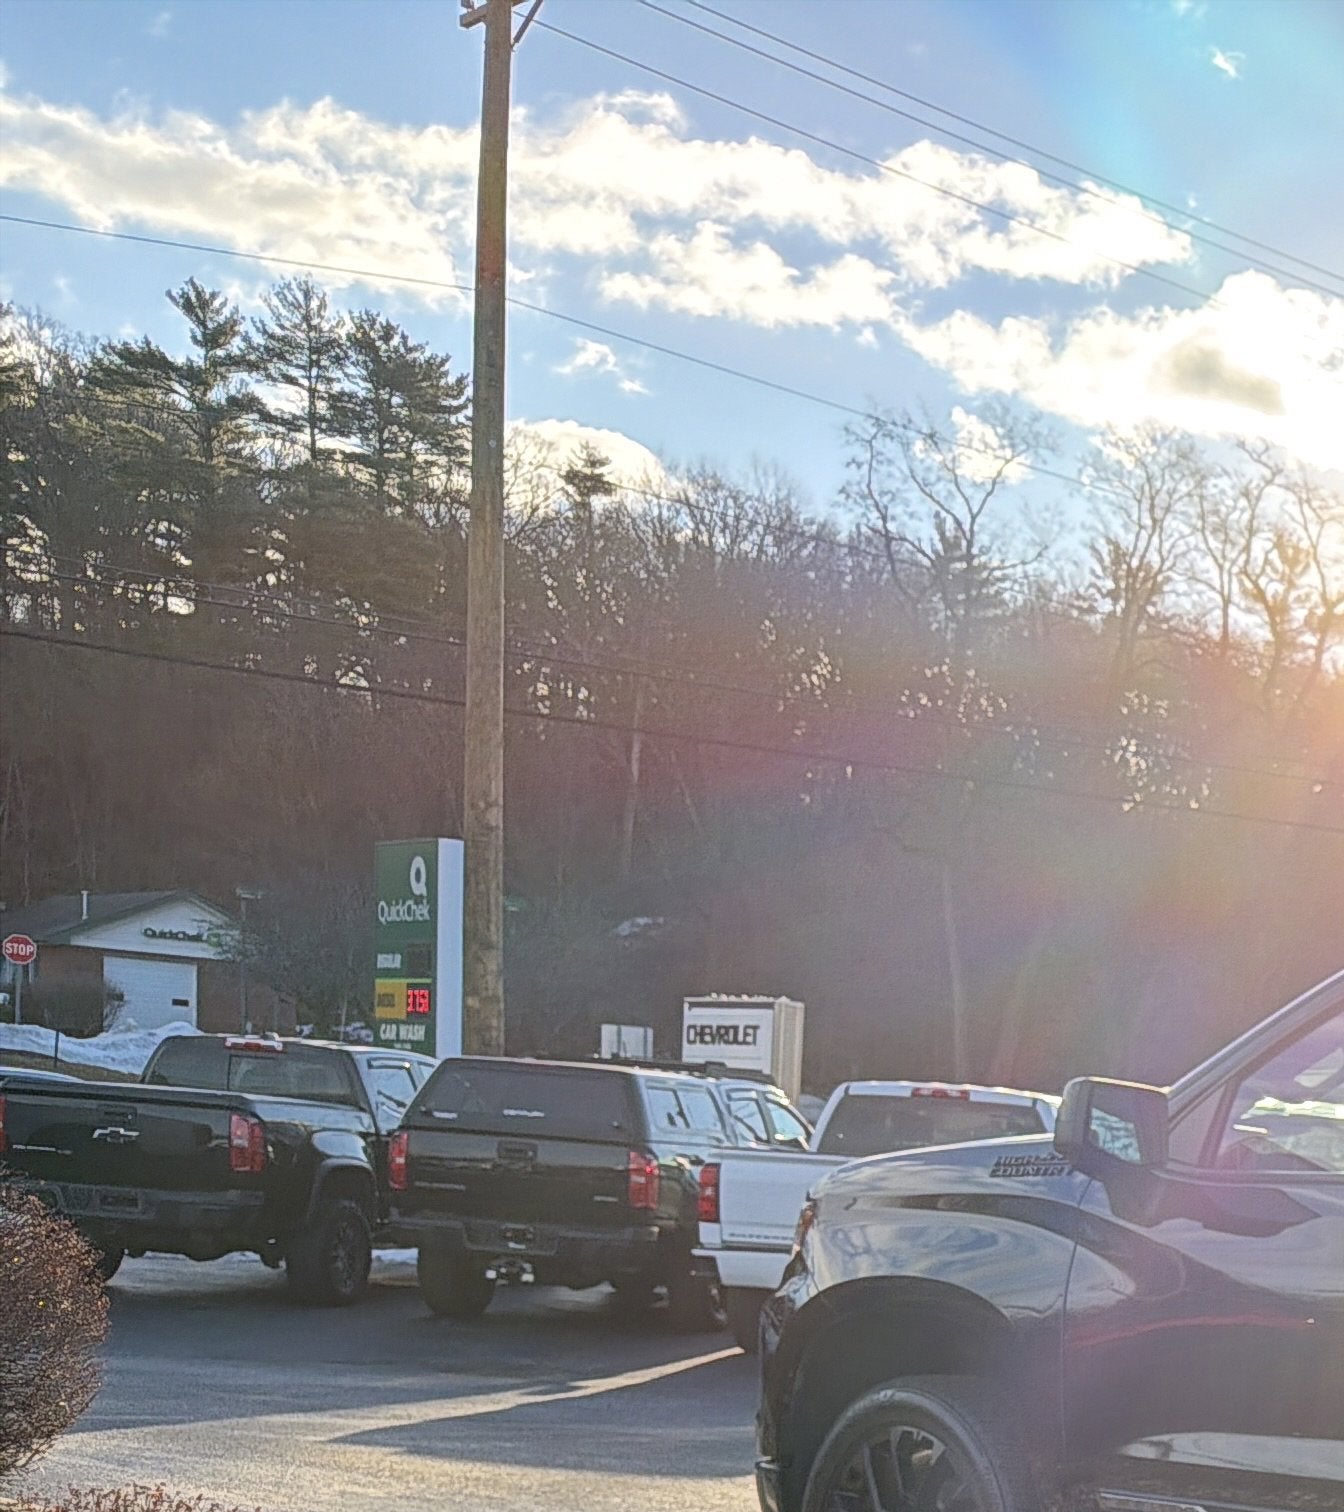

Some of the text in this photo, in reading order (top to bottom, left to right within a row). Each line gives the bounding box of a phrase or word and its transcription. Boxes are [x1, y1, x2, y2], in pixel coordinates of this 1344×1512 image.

[409, 856, 427, 896] Q
[378, 899, 430, 925] QuickChek
[5, 942, 34, 956] STOP
[380, 1023, 425, 1042] CAR WASH
[686, 1024, 760, 1046] CHEVROLET
